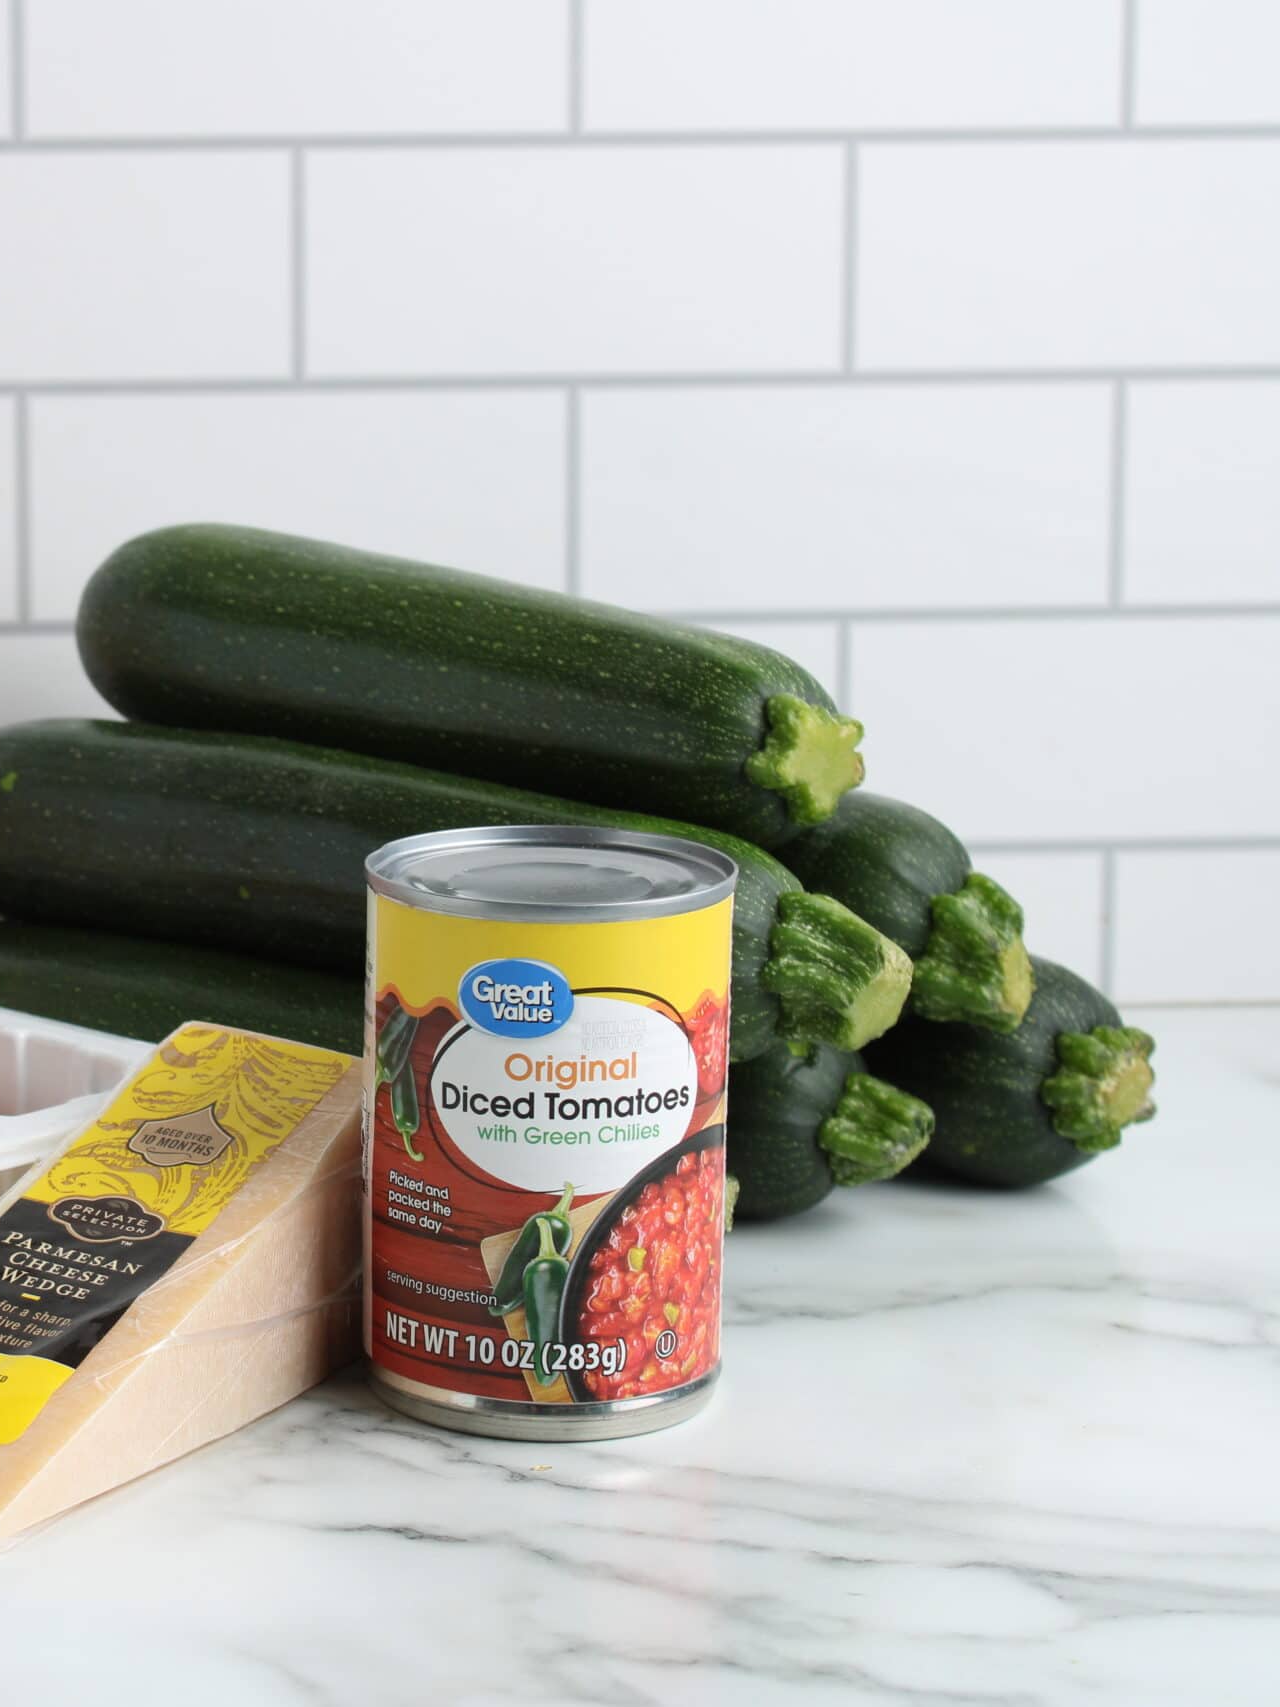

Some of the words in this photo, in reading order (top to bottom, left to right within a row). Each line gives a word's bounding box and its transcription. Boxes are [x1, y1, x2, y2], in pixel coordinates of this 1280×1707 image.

[472, 975, 553, 1006] Great
[489, 1002, 553, 1023] Value
[504, 1052, 638, 1090] Original
[441, 1081, 535, 1120] Diced
[544, 1083, 690, 1121] Tomatoes
[140, 1133, 156, 1145] 10
[157, 1136, 215, 1157] MONTHS
[154, 1126, 184, 1139] AGED
[184, 1131, 213, 1144] OVER
[477, 1120, 518, 1143] with
[524, 1127, 592, 1145] Green
[598, 1121, 660, 1145] Chilies
[388, 1170, 424, 1193] Picked
[425, 1185, 449, 1201] and
[71, 1203, 149, 1228] PRIVATE
[388, 1190, 430, 1213] packed
[432, 1201, 452, 1218] the
[61, 1210, 148, 1235] SELECTION
[387, 1206, 417, 1225] same
[419, 1215, 443, 1234] day
[1, 1231, 143, 1276] PARMESAN
[0, 1265, 92, 1301] WEDGE
[8, 1251, 110, 1287] CHEESE
[387, 1270, 423, 1295] serving
[426, 1283, 498, 1306] suggestion
[19, 1307, 30, 1318] a
[23, 1322, 66, 1338] flavor
[386, 1310, 419, 1348] NET
[423, 1323, 459, 1358] WT
[464, 1335, 495, 1365] 10
[500, 1339, 535, 1369] OZ
[541, 1338, 627, 1376] (283g)
